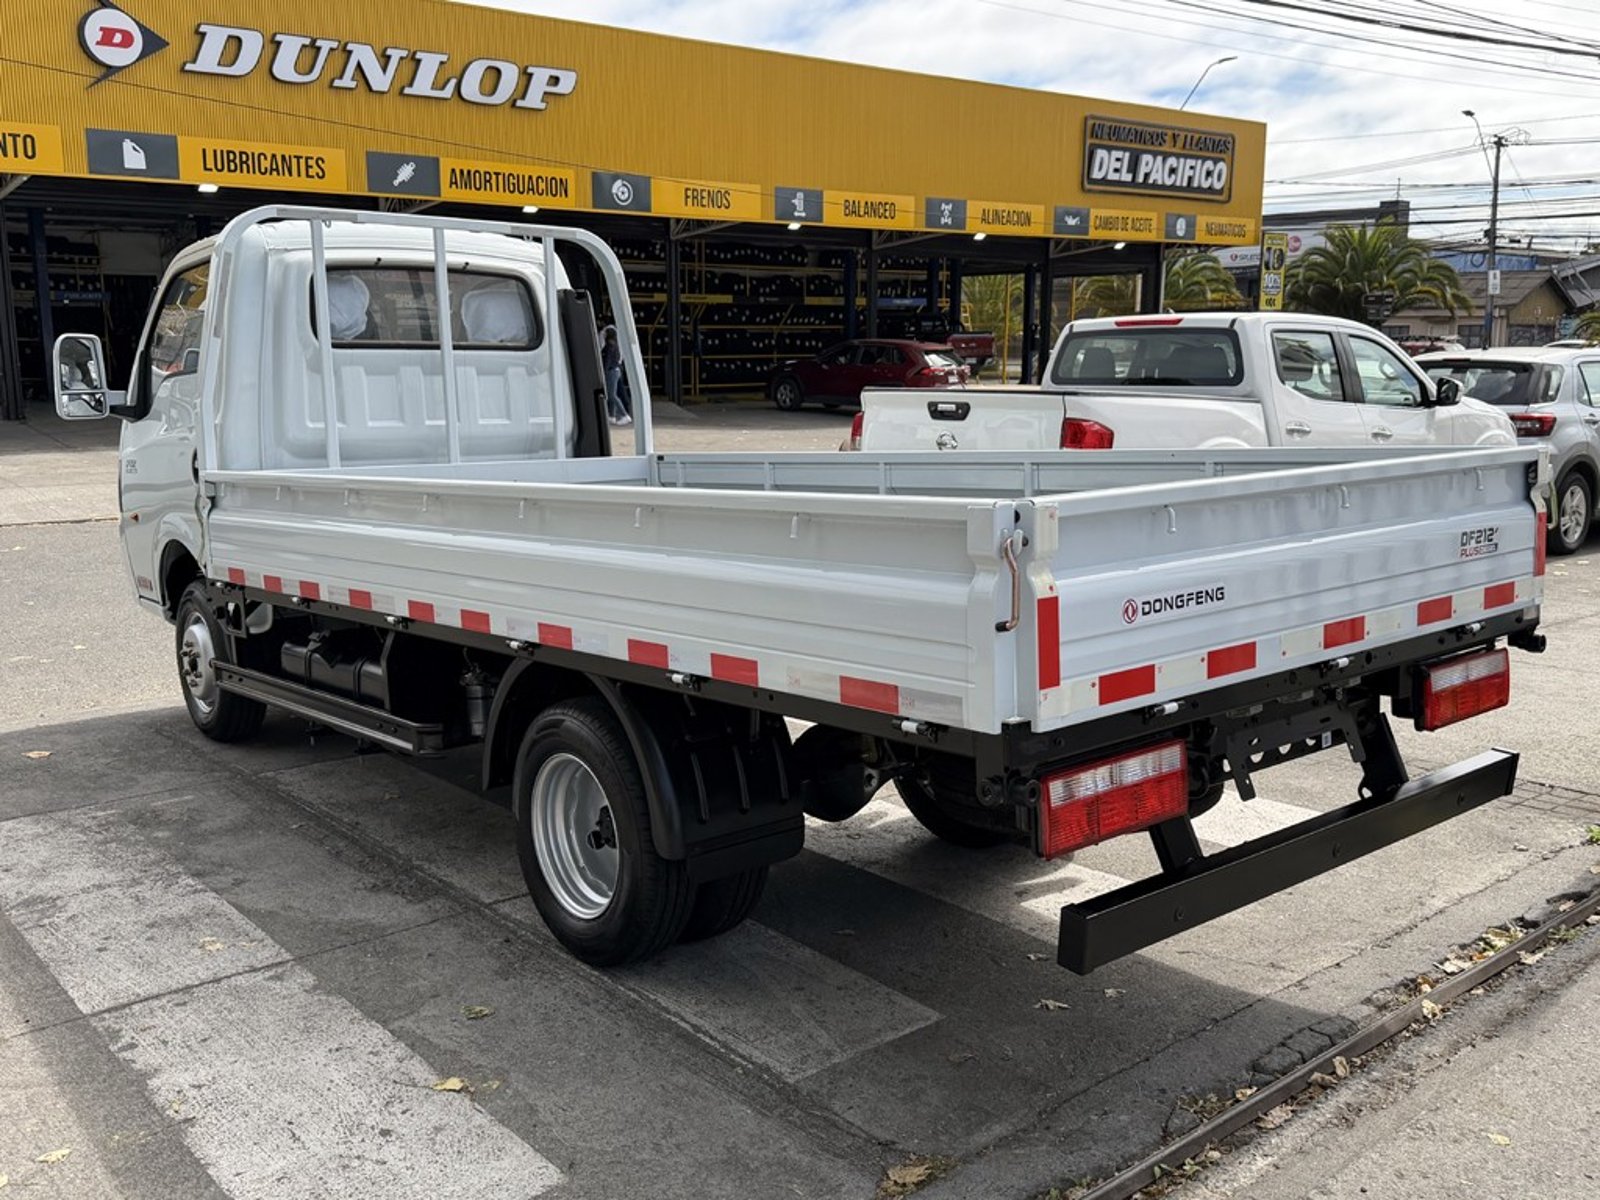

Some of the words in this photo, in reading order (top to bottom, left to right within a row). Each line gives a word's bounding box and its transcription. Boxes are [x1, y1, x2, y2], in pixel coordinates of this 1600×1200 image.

[183, 23, 577, 111] DUNLOP
[202, 147, 326, 180] LUBRICANTES
[1090, 148, 1133, 182] DEL
[1136, 153, 1227, 190] PACIFICO
[448, 167, 569, 198] AMORTIGUACION
[684, 187, 731, 210] FRENOS
[843, 198, 896, 220] BALANCEO
[981, 208, 1031, 227] ALINEACION
[1141, 586, 1225, 616] DONGFENG
